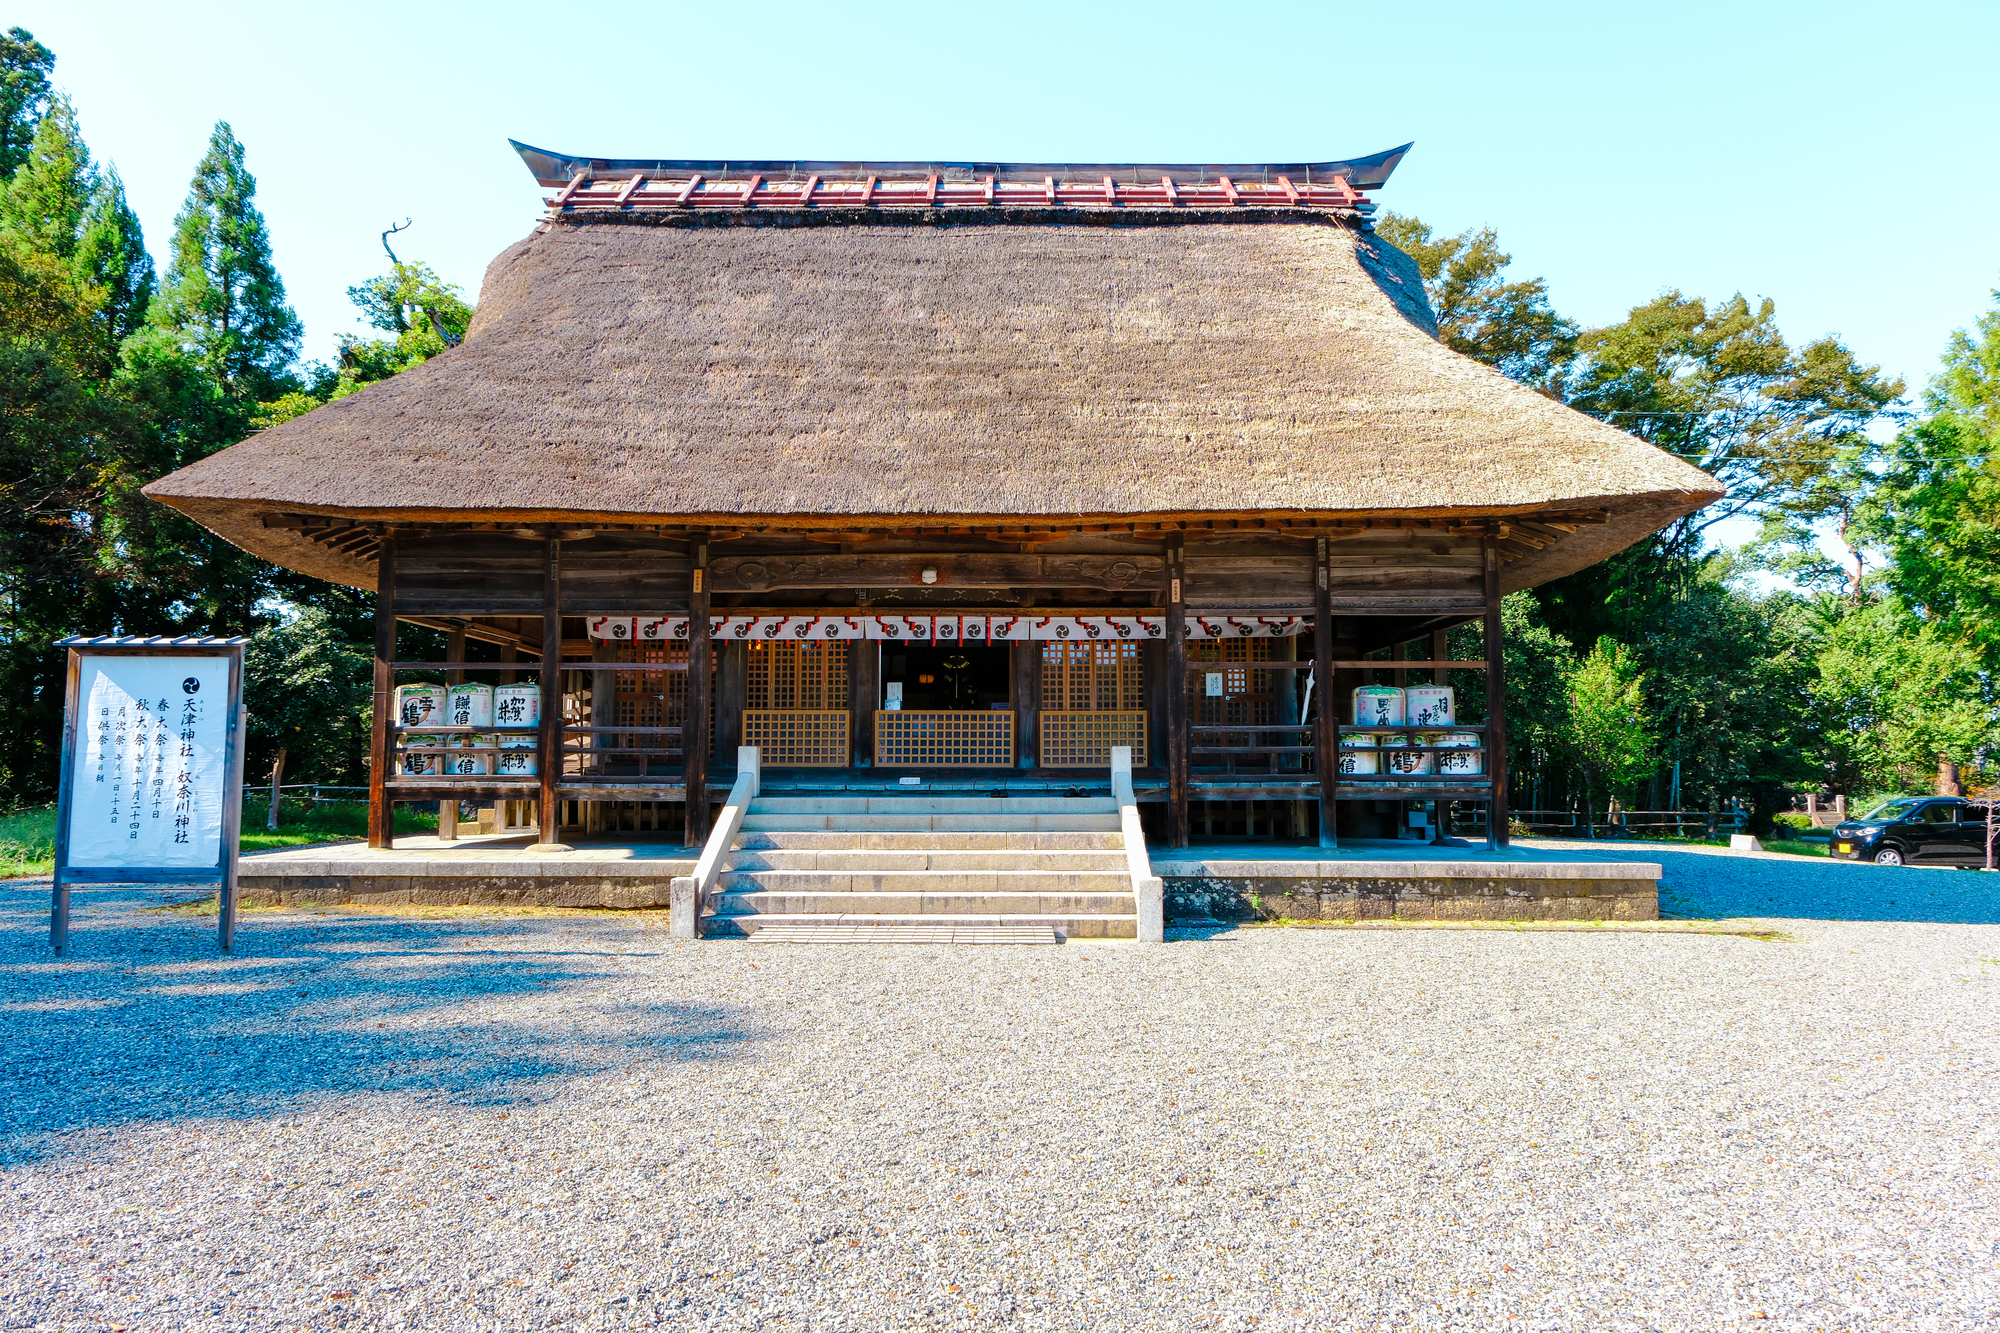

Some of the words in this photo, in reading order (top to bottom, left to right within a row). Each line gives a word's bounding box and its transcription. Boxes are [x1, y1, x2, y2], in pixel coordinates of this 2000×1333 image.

[97, 707, 110, 745] 日供祭
[115, 706, 127, 745] 月次祭
[134, 698, 150, 746] 秋大祭
[154, 698, 170, 746] 春大祭
[453, 695, 471, 725] 謙信
